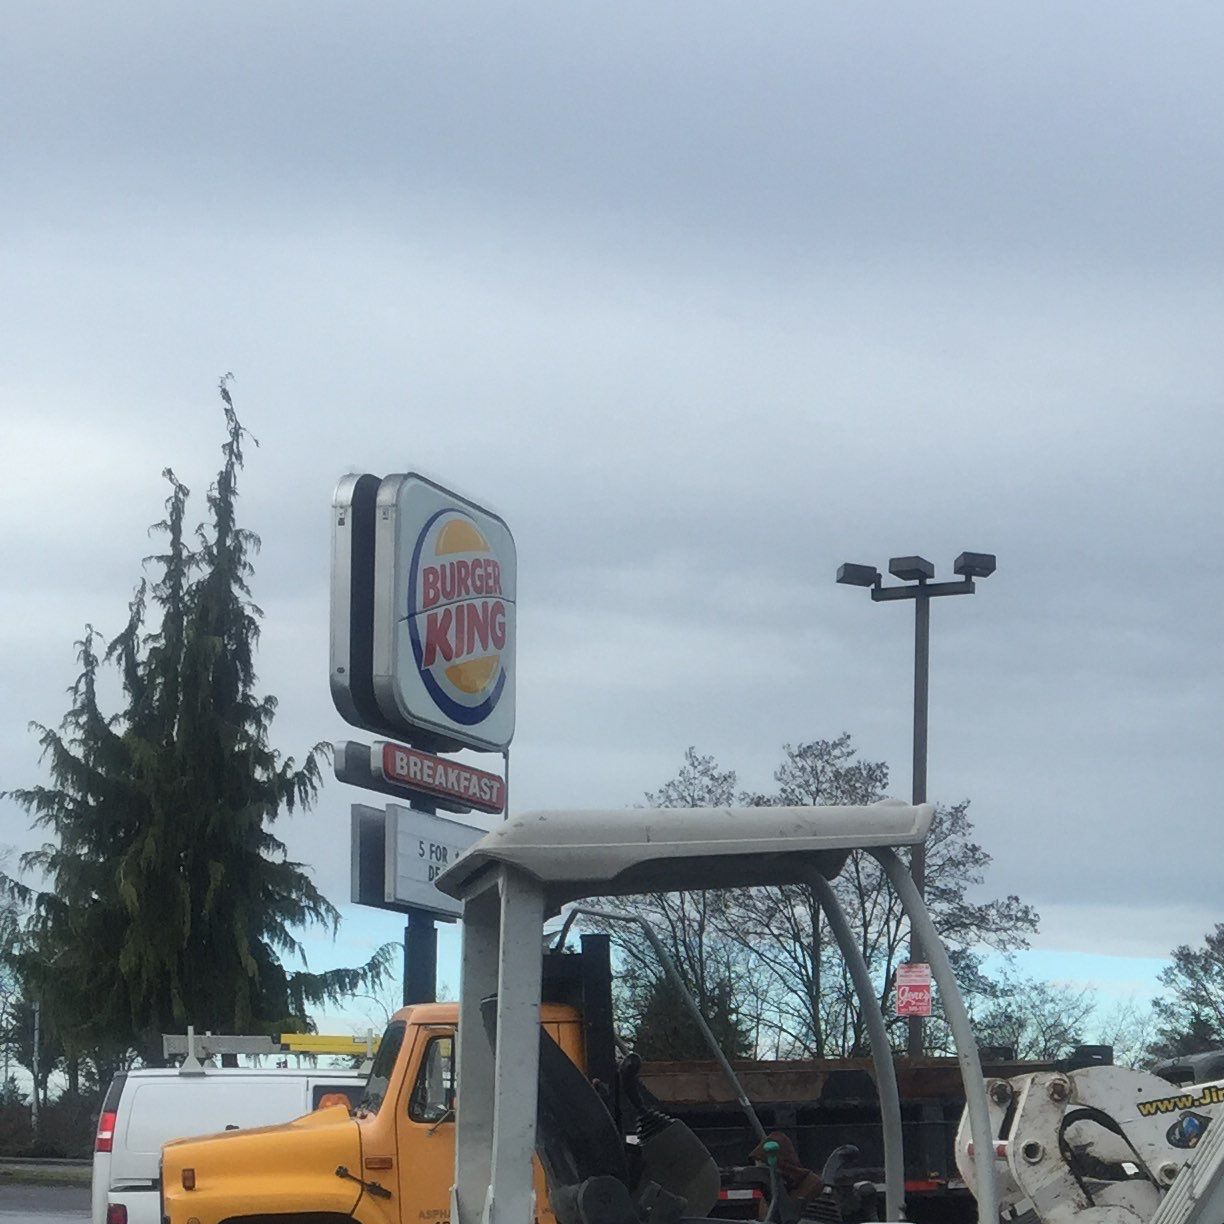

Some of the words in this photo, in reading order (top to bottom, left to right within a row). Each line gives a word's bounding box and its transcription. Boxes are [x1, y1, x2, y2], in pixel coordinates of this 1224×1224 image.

[422, 558, 503, 609] BURGER
[423, 600, 506, 667] KING
[394, 750, 500, 803] BREAKFAST
[418, 840, 425, 858] 5
[429, 843, 448, 864] FOR
